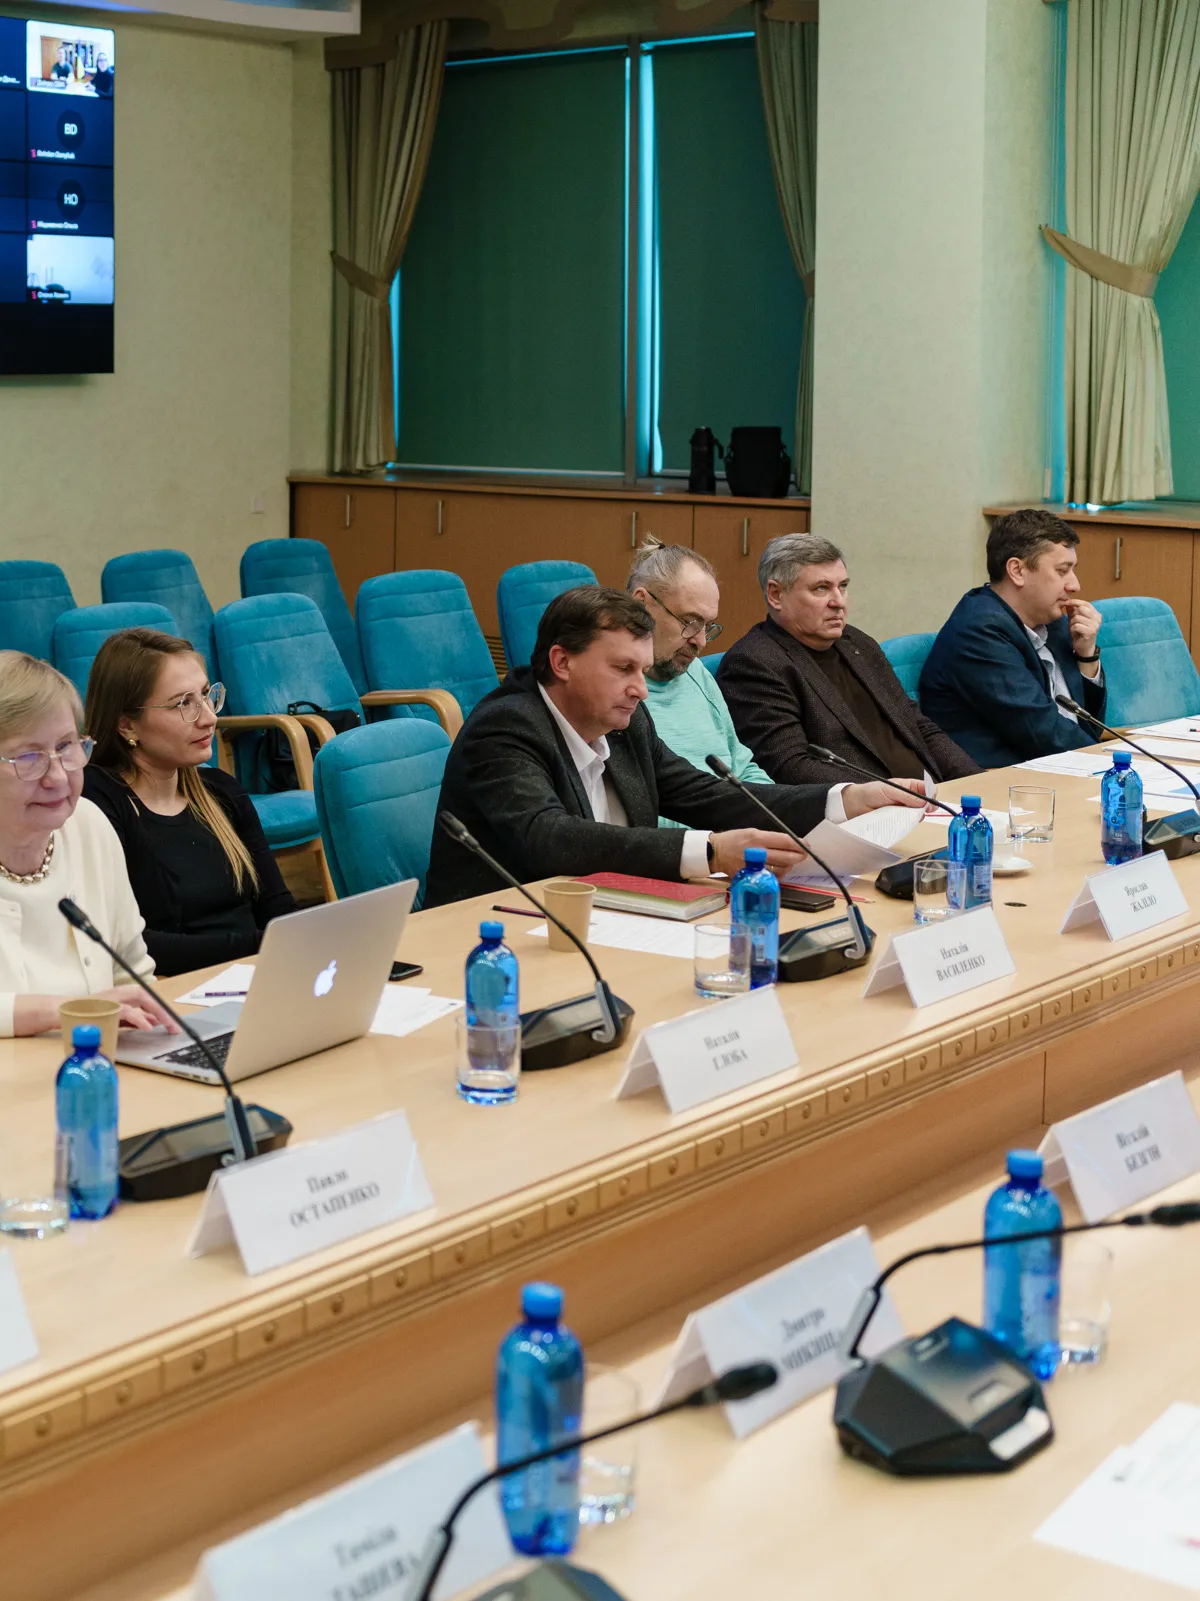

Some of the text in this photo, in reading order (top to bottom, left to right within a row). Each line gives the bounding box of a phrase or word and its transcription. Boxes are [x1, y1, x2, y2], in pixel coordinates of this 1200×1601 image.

[64, 123, 78, 135] BD
[939, 941, 969, 960] Наталія
[936, 955, 986, 982] ВАСИЛЕНКО
[307, 1170, 349, 1194] Павло
[289, 1182, 380, 1228] ОСТАПЕНКО
